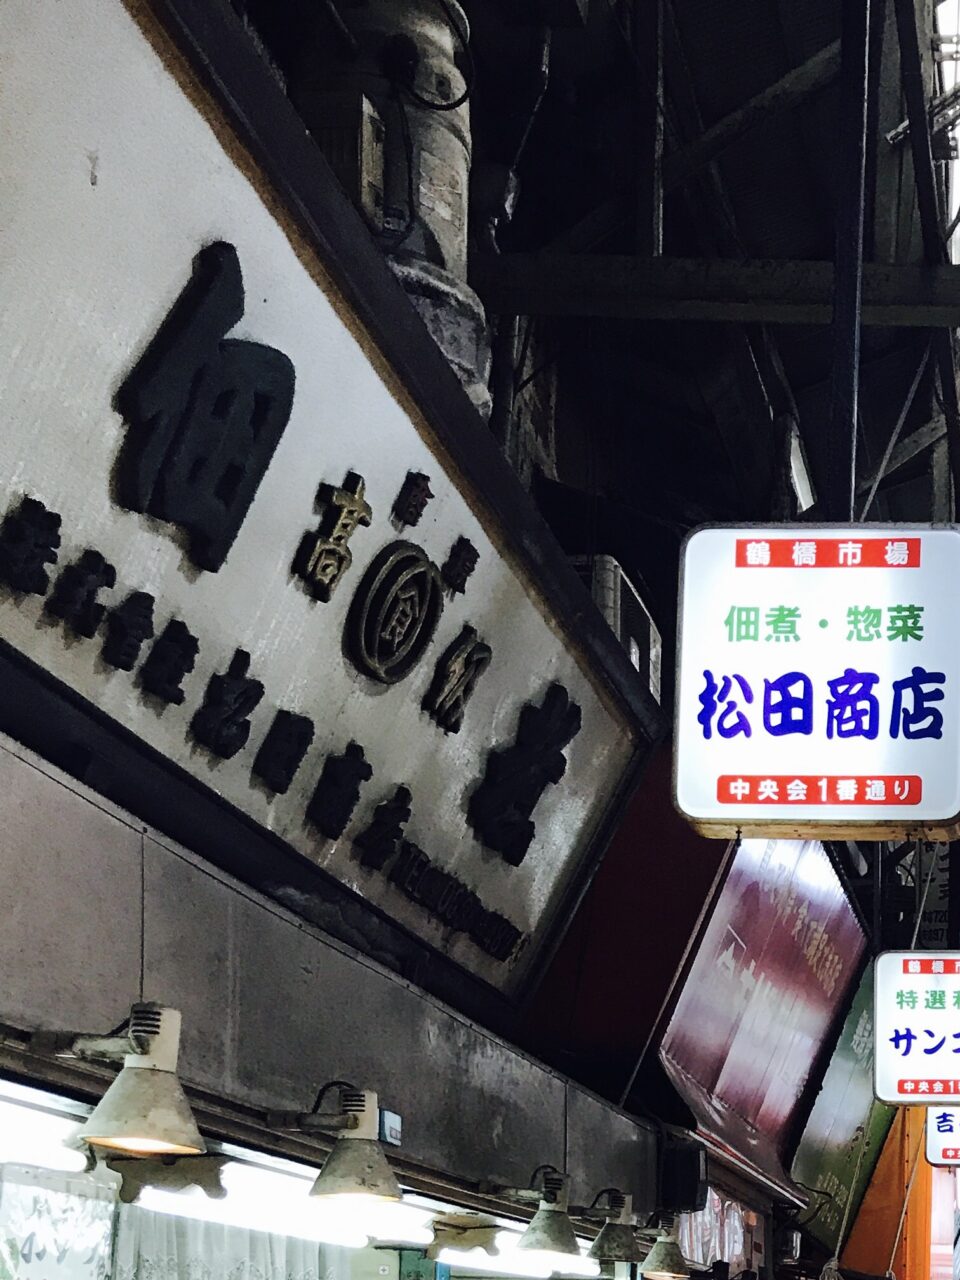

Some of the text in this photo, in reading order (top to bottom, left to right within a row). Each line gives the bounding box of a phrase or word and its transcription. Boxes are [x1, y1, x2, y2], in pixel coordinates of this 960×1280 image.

[746, 541, 910, 566] 鶴橋市場
[724, 604, 925, 642] 佃煮・惣菜
[697, 666, 946, 740] 松田商店
[729, 778, 911, 802] 中央会1番通り
